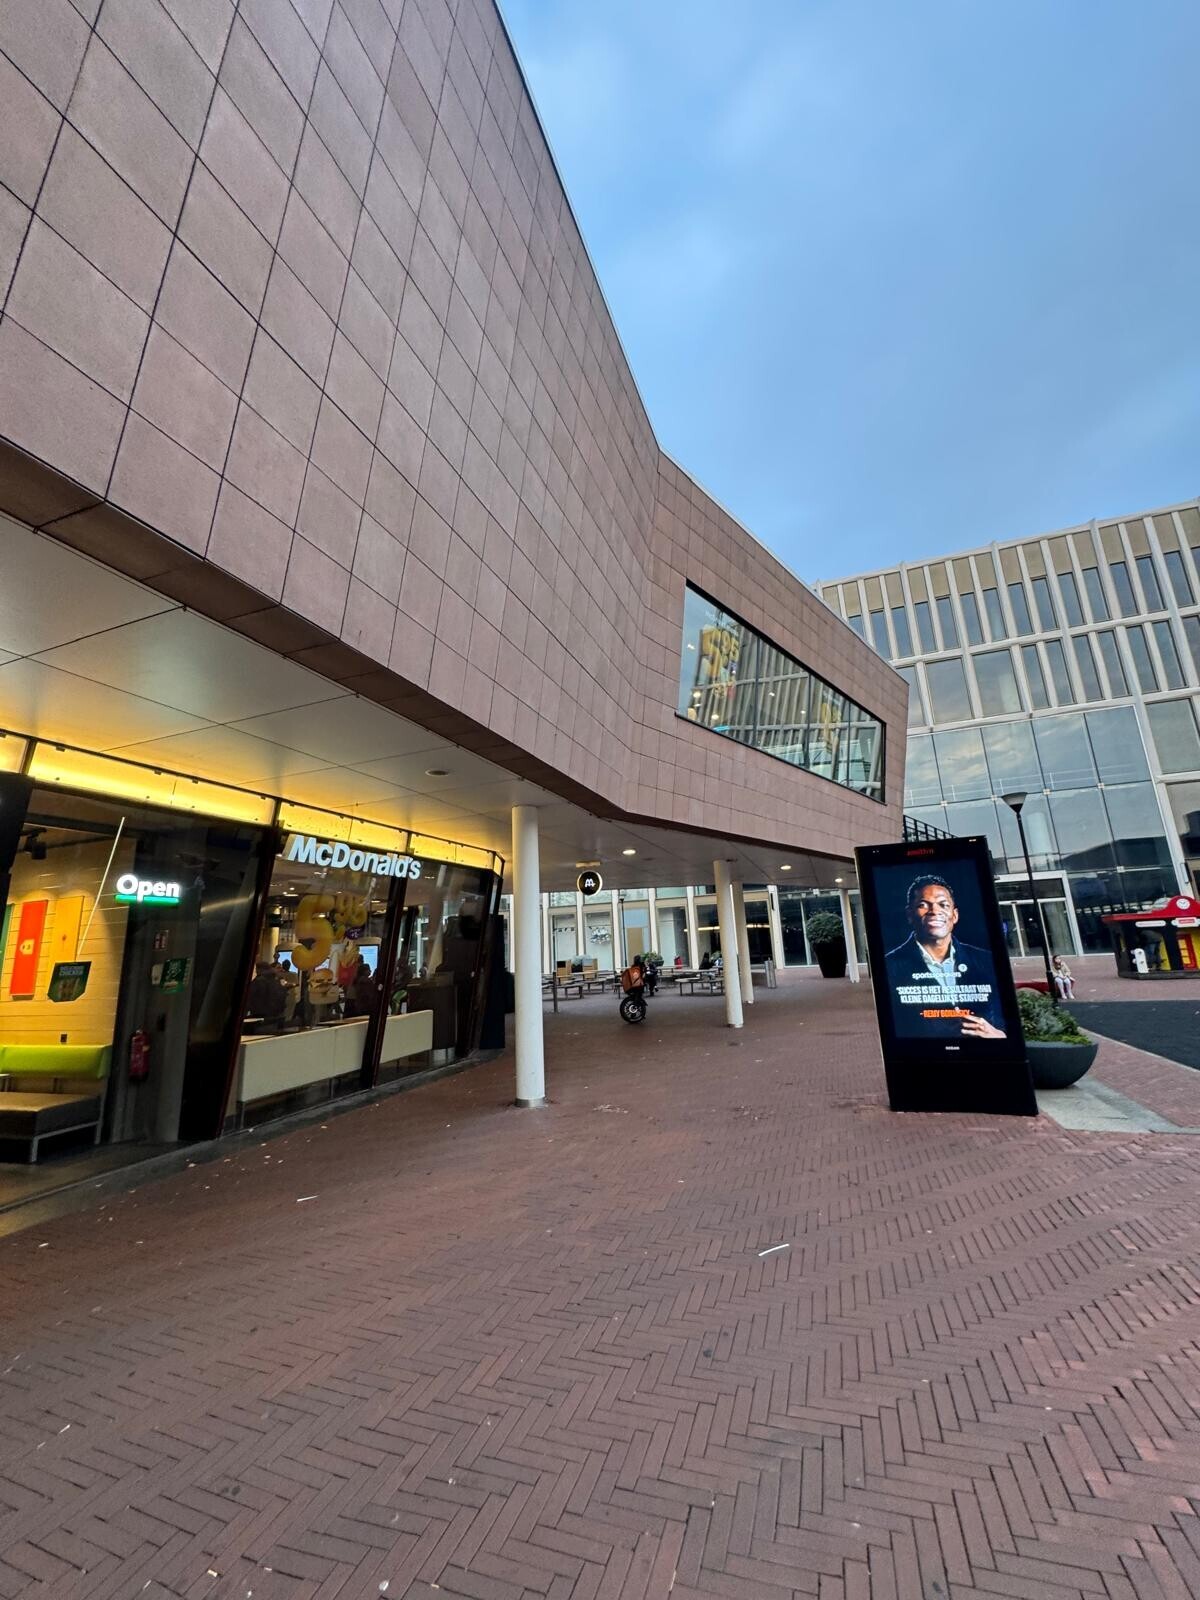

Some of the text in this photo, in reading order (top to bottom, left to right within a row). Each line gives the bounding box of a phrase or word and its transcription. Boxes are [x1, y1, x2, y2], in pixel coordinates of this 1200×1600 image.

[287, 834, 422, 880] McDonald's
[116, 874, 181, 902] Open
[922, 986, 928, 994] IS
[928, 986, 941, 994] HET
